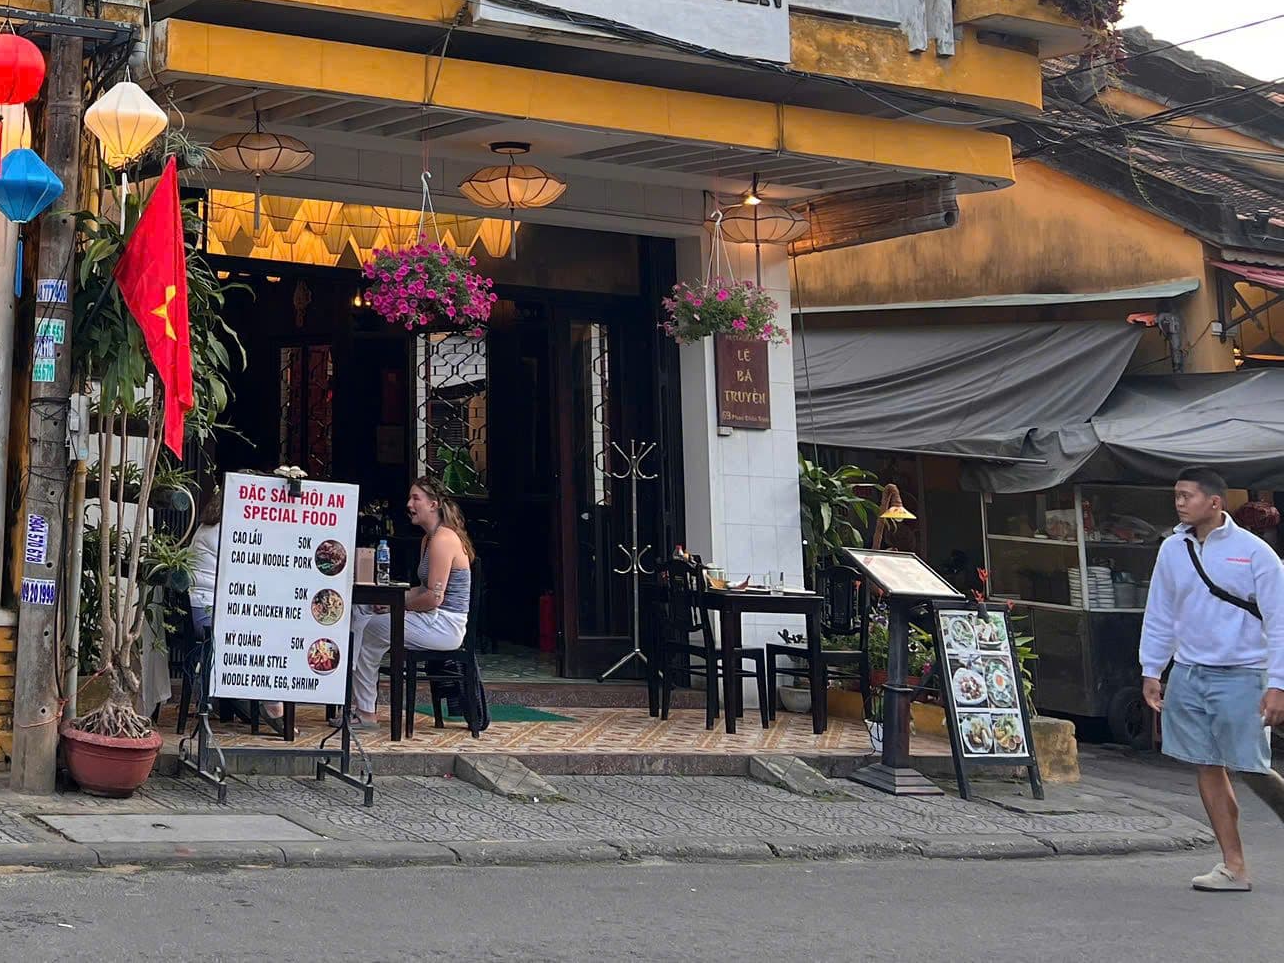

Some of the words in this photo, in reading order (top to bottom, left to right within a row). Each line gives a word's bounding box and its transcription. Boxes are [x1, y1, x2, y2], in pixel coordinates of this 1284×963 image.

[239, 483, 266, 503] ĐẶC
[300, 488, 323, 509] HỘI
[327, 493, 345, 508] AN
[243, 505, 298, 523] SPECIAL
[302, 510, 337, 526] FOOD
[232, 530, 247, 545] CAO
[298, 536, 312, 549] 50K
[231, 550, 246, 564] CAO
[247, 551, 261, 566] LAU
[262, 553, 290, 568] NOODLE
[293, 556, 313, 569] PORK
[294, 587, 308, 600] 50K
[227, 602, 240, 616] HOI
[241, 603, 251, 617] AN
[252, 604, 284, 619] CHICKEN
[285, 606, 302, 620] RICE
[290, 637, 305, 650] 50K
[223, 652, 247, 666] QUANG
[248, 653, 265, 668] NAM
[266, 655, 288, 669] STYLE
[221, 672, 249, 687] NOODLE
[250, 674, 272, 690] PORK,
[291, 677, 319, 691] SHRIMP
